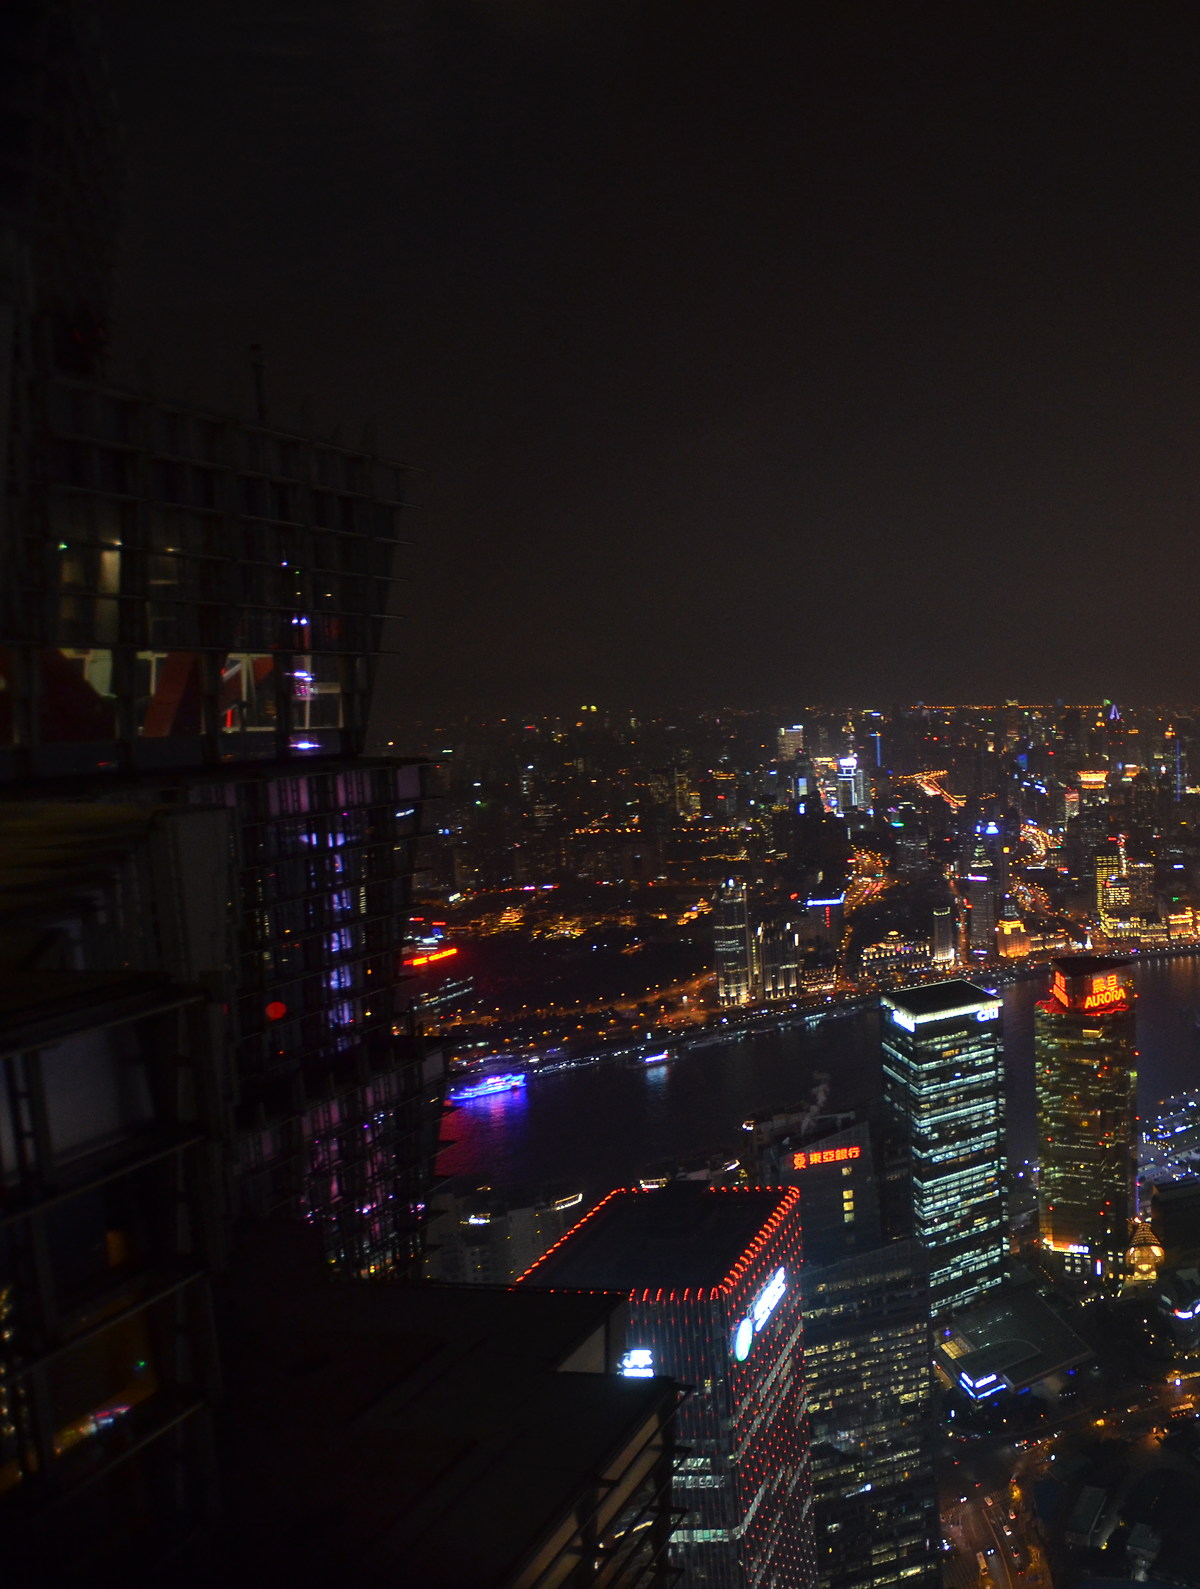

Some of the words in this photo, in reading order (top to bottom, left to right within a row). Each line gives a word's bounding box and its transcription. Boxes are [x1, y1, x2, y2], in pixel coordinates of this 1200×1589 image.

[1084, 988, 1126, 1009] AURORA
[809, 1147, 861, 1165] 東亞銀行
